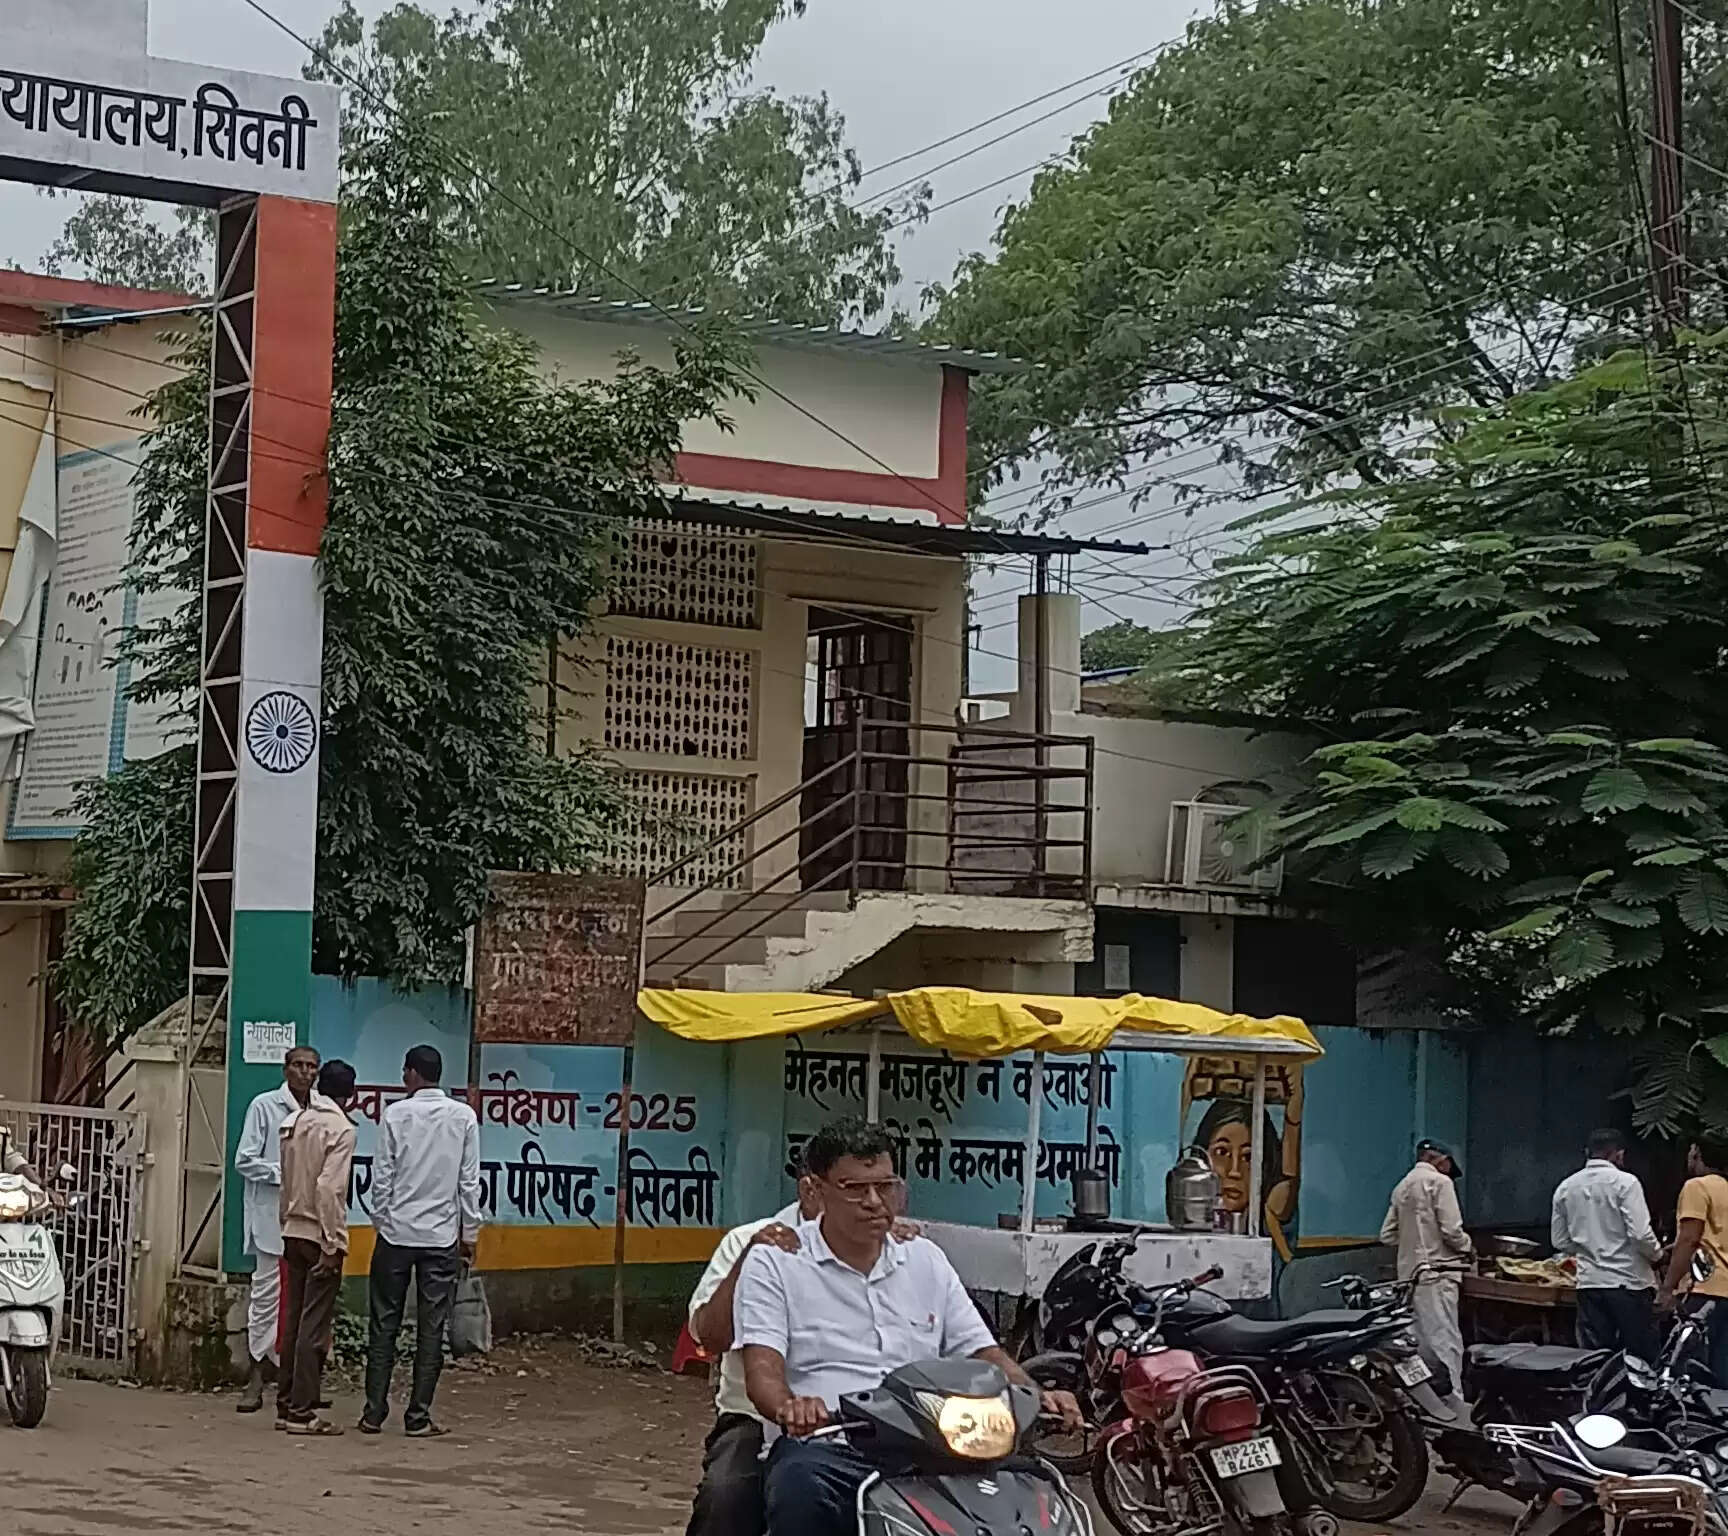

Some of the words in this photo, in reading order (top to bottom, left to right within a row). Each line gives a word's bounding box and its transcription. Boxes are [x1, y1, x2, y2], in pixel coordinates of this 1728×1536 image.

[193, 82, 317, 170] सिवनी
[245, 1024, 293, 1044] न्यायालय
[625, 1146, 720, 1229] सिवनी
